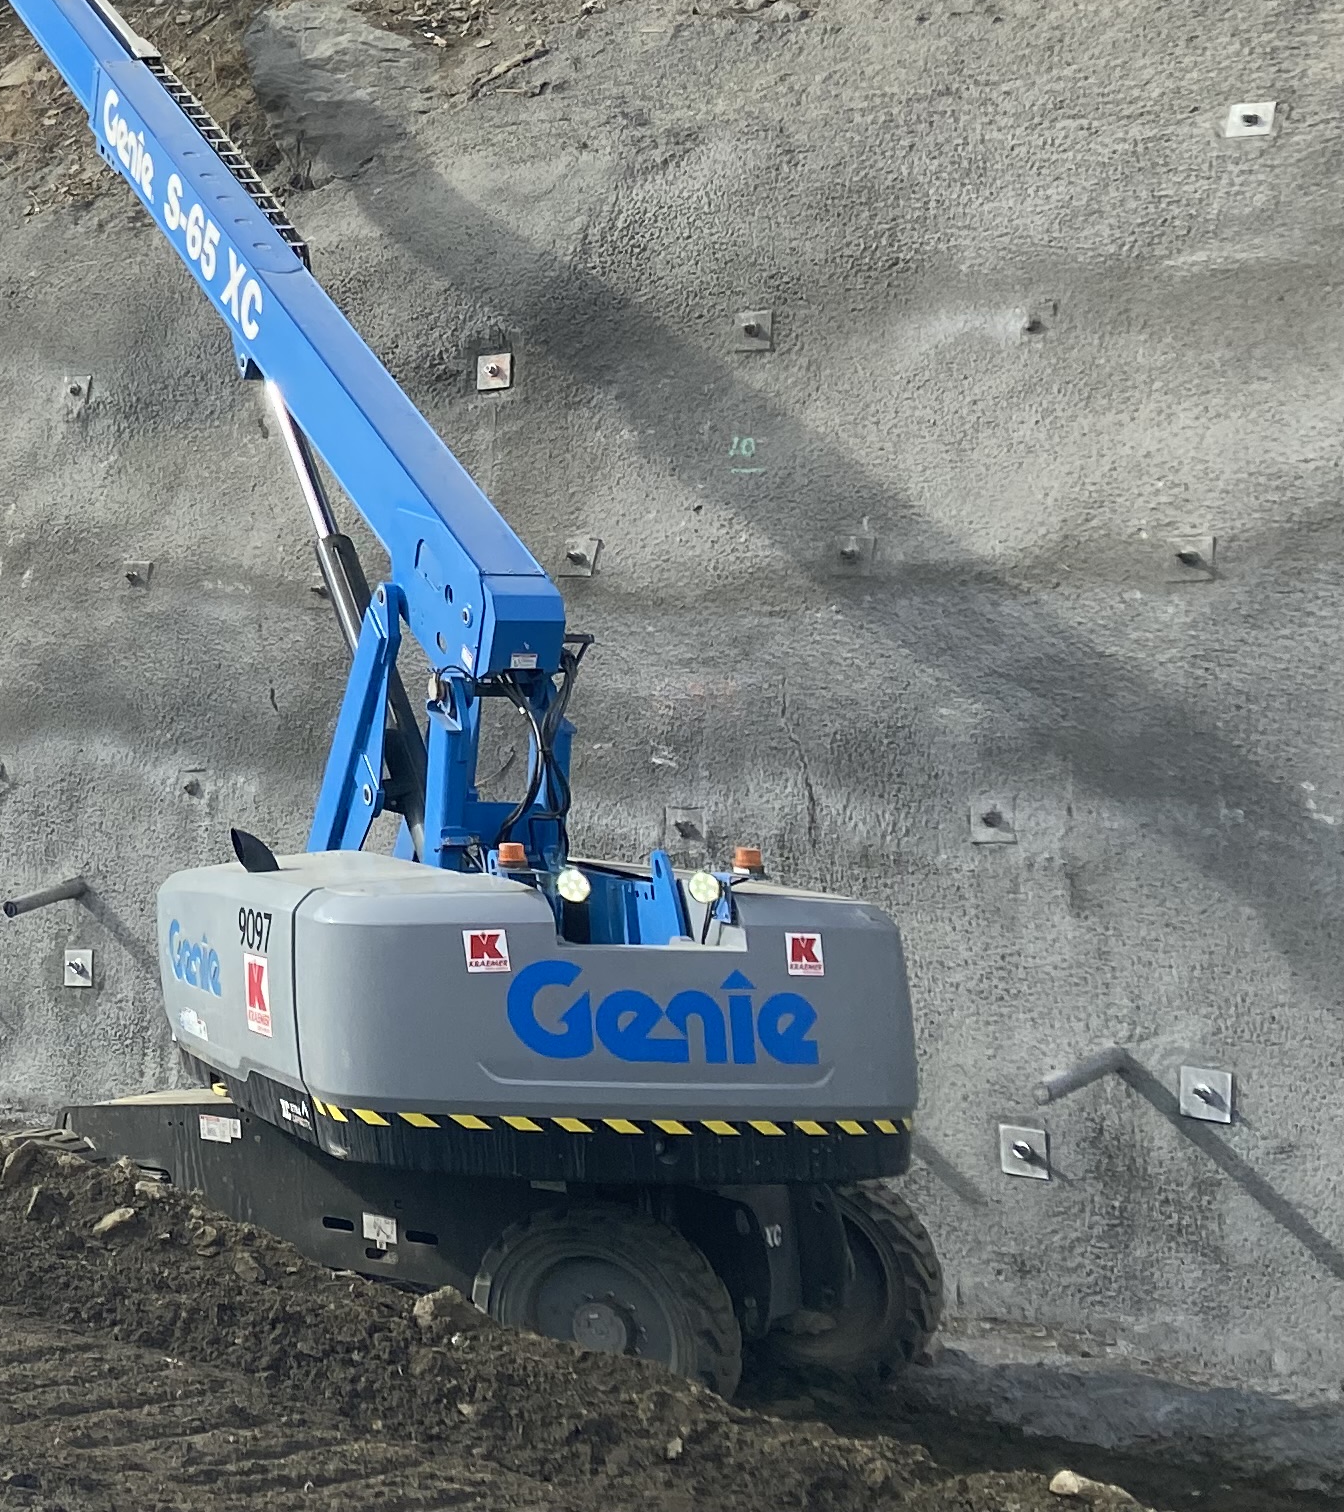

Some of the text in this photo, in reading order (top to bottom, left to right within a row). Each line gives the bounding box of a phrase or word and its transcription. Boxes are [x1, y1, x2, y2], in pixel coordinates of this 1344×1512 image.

[103, 89, 263, 340] Genie S-65 XC
[238, 907, 272, 953] 9097
[470, 932, 504, 959] K
[792, 936, 819, 962] K
[169, 918, 222, 998] Genie
[469, 959, 508, 968] KRAEMER
[506, 959, 820, 1065] Genie
